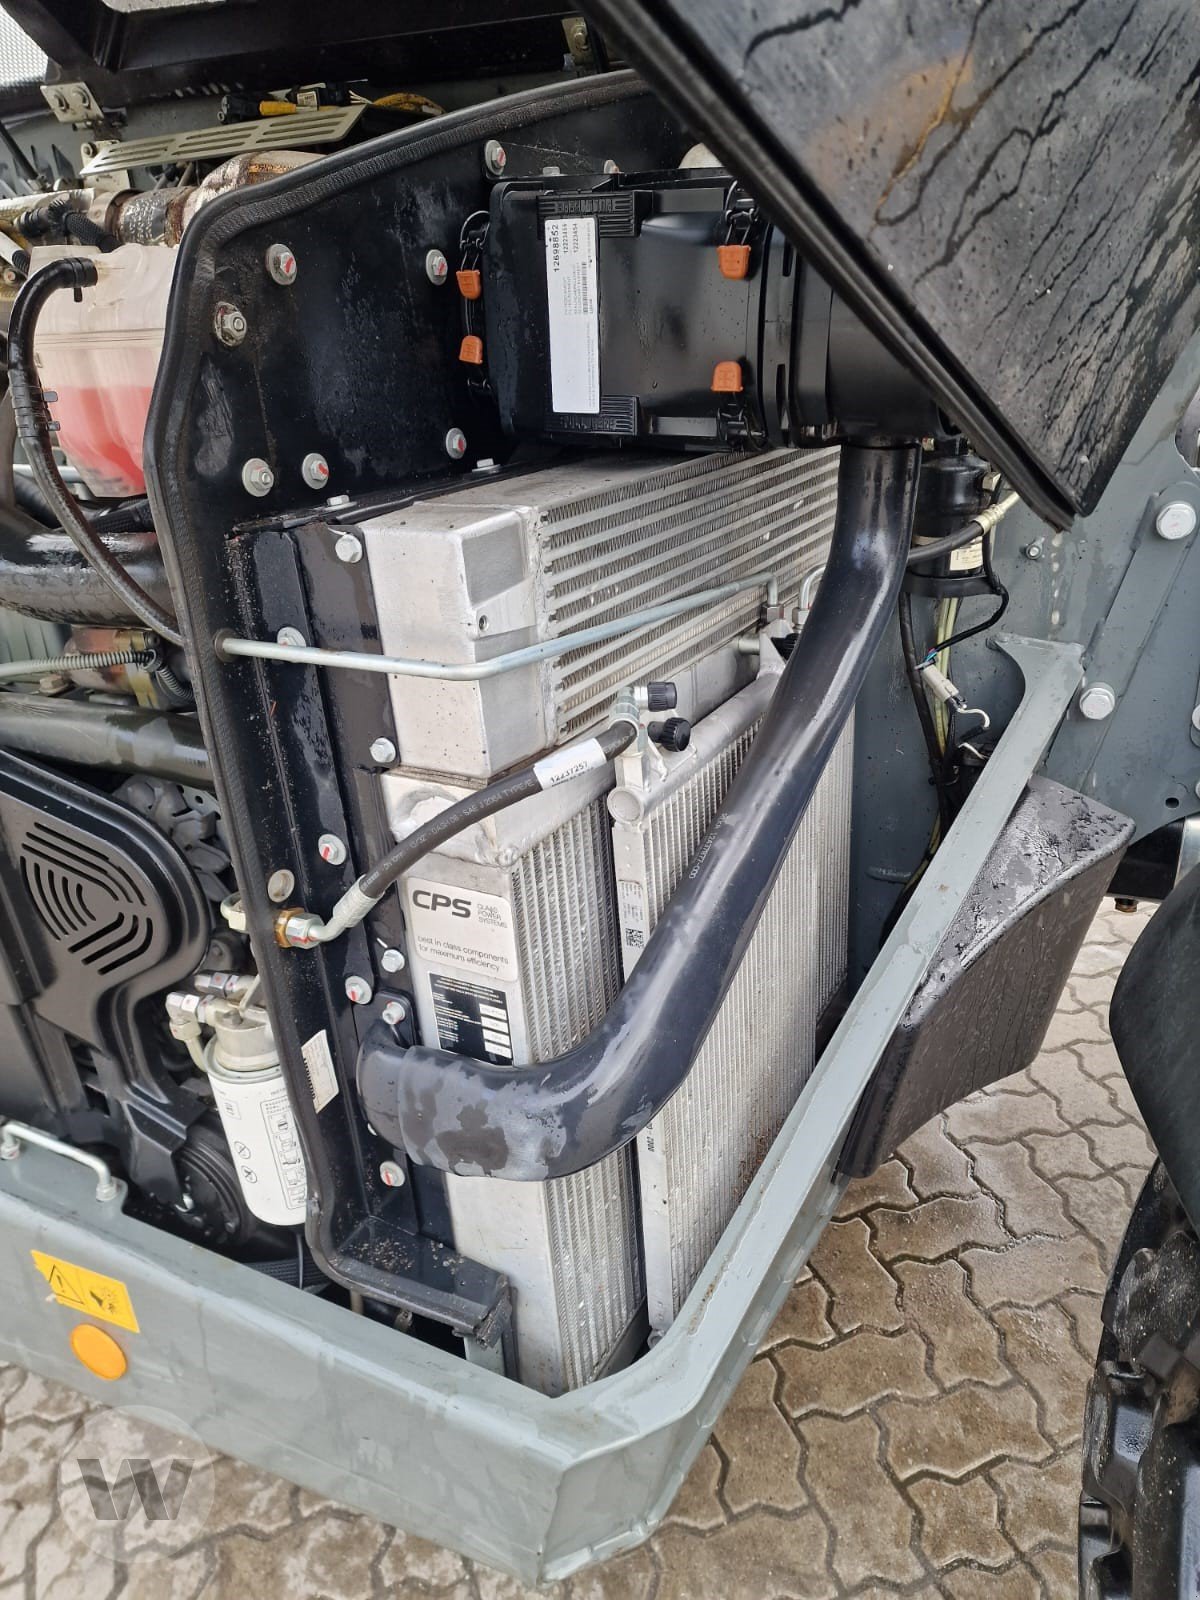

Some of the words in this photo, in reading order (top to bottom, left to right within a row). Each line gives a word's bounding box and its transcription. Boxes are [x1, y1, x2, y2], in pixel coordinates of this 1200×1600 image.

[551, 224, 561, 273] 12698852
[462, 805, 478, 816] SAE
[412, 889, 472, 918] CPS
[418, 943, 430, 953] for
[429, 948, 465, 963] maximum
[466, 955, 501, 972] efficiency
[442, 942, 462, 953] class
[462, 946, 509, 965] components
